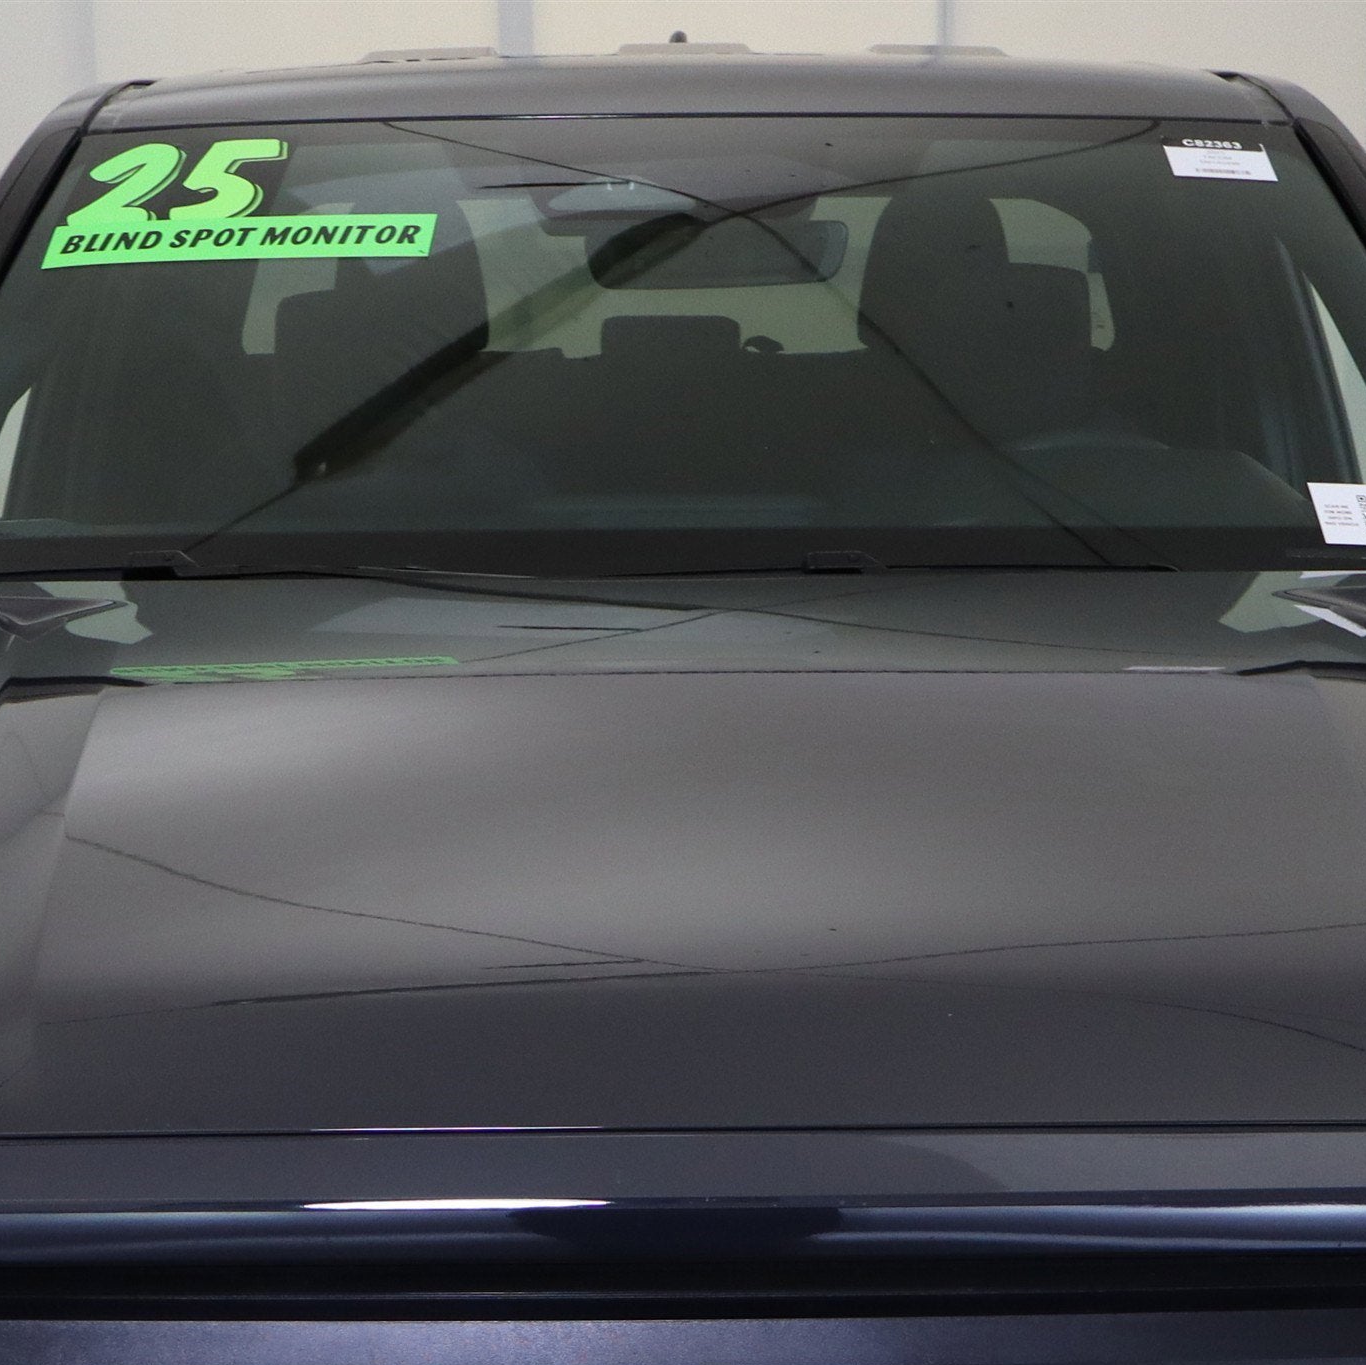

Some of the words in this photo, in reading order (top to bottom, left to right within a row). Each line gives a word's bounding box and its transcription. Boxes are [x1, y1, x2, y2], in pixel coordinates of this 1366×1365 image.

[66, 138, 288, 225] 25
[60, 229, 163, 254] BLIND
[169, 227, 257, 249] SPOT
[260, 224, 422, 247] MONITOR
